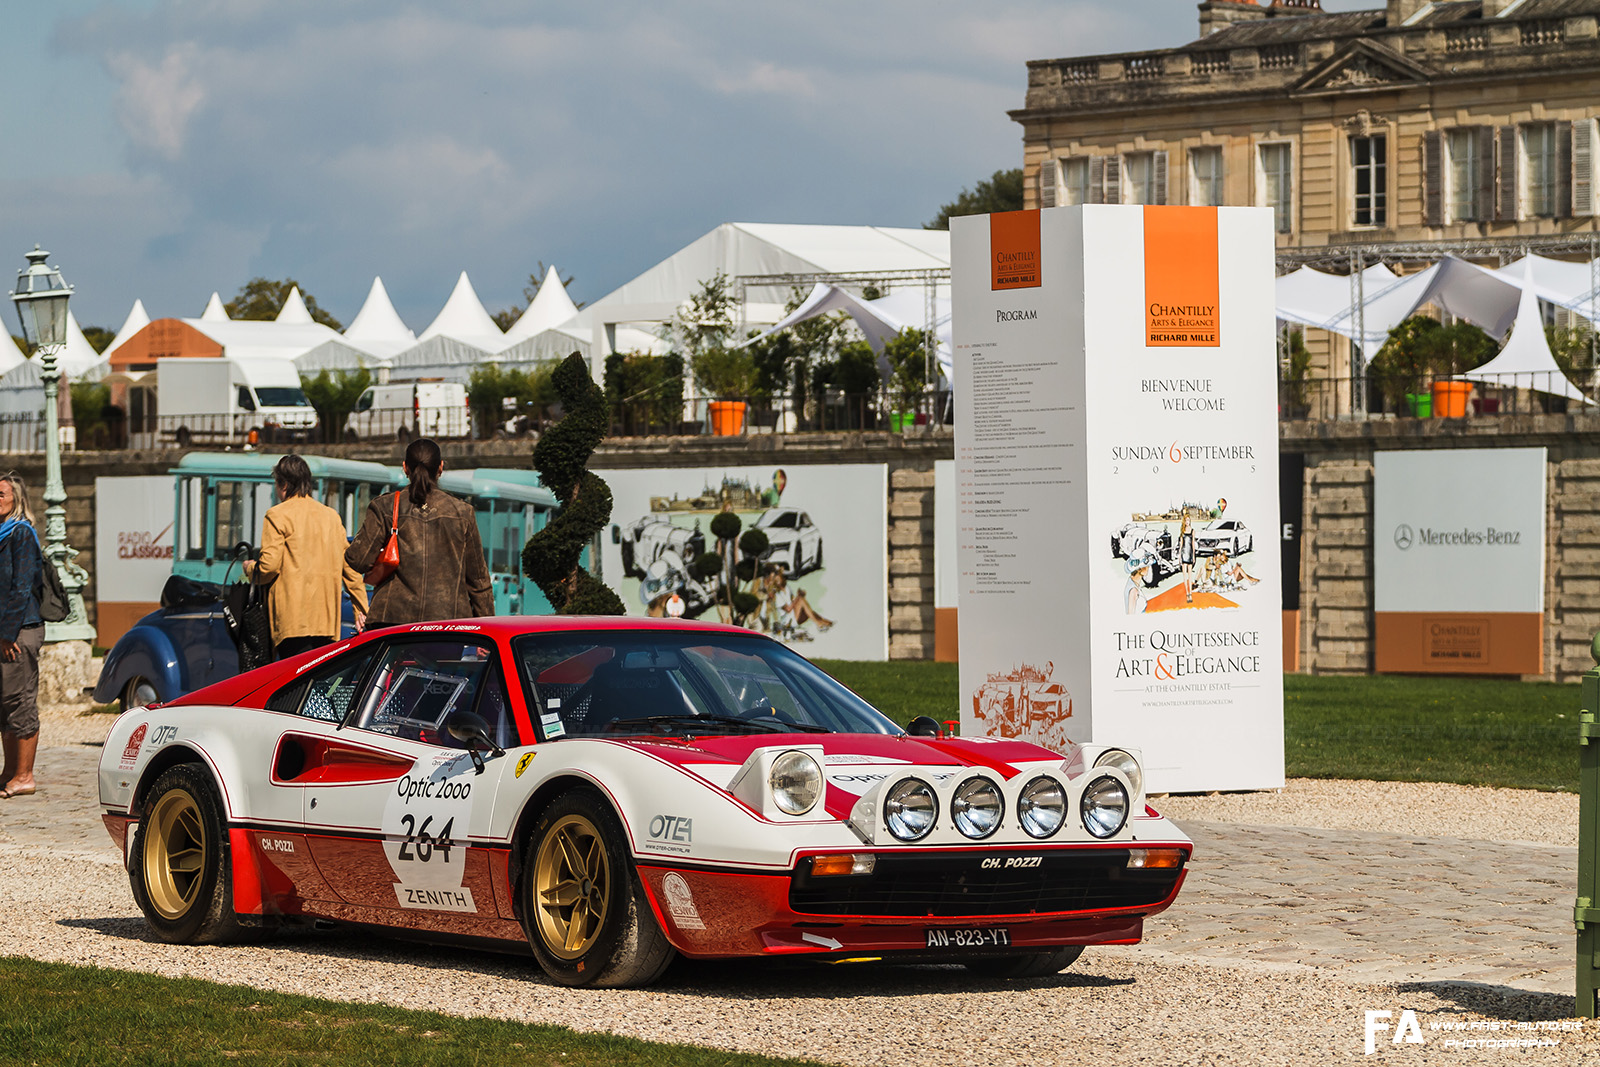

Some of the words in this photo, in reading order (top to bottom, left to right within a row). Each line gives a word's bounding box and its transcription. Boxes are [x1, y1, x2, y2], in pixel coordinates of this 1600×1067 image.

[997, 251, 1035, 263] CHANTILLY
[997, 276, 1019, 284] RICHARD
[996, 309, 1037, 322] PROGRAM
[1150, 303, 1214, 317] CHANTILLY
[1170, 318, 1176, 326] &
[1178, 318, 1214, 326] ELEGANCE
[1141, 379, 1212, 392] BIENVENUE
[1162, 397, 1225, 411] WELCOME
[1112, 446, 1166, 460] SUNDAY
[1169, 440, 1182, 463] 6
[1183, 446, 1255, 460] SEPTEMBER
[117, 531, 152, 545] RADIO
[1419, 527, 1521, 545] Mercedes-Benz
[118, 545, 174, 559] CLASSIQUE
[1113, 632, 1145, 651] THE
[1150, 630, 1259, 654] QUINTESSENCE
[1185, 648, 1195, 656] OF
[1115, 657, 1153, 678] ART
[1154, 653, 1177, 680] &
[1176, 655, 1260, 676] ELEGANCE
[1145, 685, 1154, 693] AT
[1155, 685, 1168, 693] THE
[1169, 683, 1208, 693] CHANTILLY
[1209, 683, 1231, 691] ESTATE
[397, 775, 435, 805] Optic
[435, 776, 471, 800] 2000
[649, 814, 693, 842] OTEA
[398, 813, 455, 863] 264
[261, 838, 274, 850] CH.
[274, 839, 295, 853] POZZI
[981, 858, 1001, 869] CH.
[1004, 857, 1043, 868] POZZI
[404, 888, 467, 907] ZENITH
[927, 929, 1008, 947] AN-823-YT
